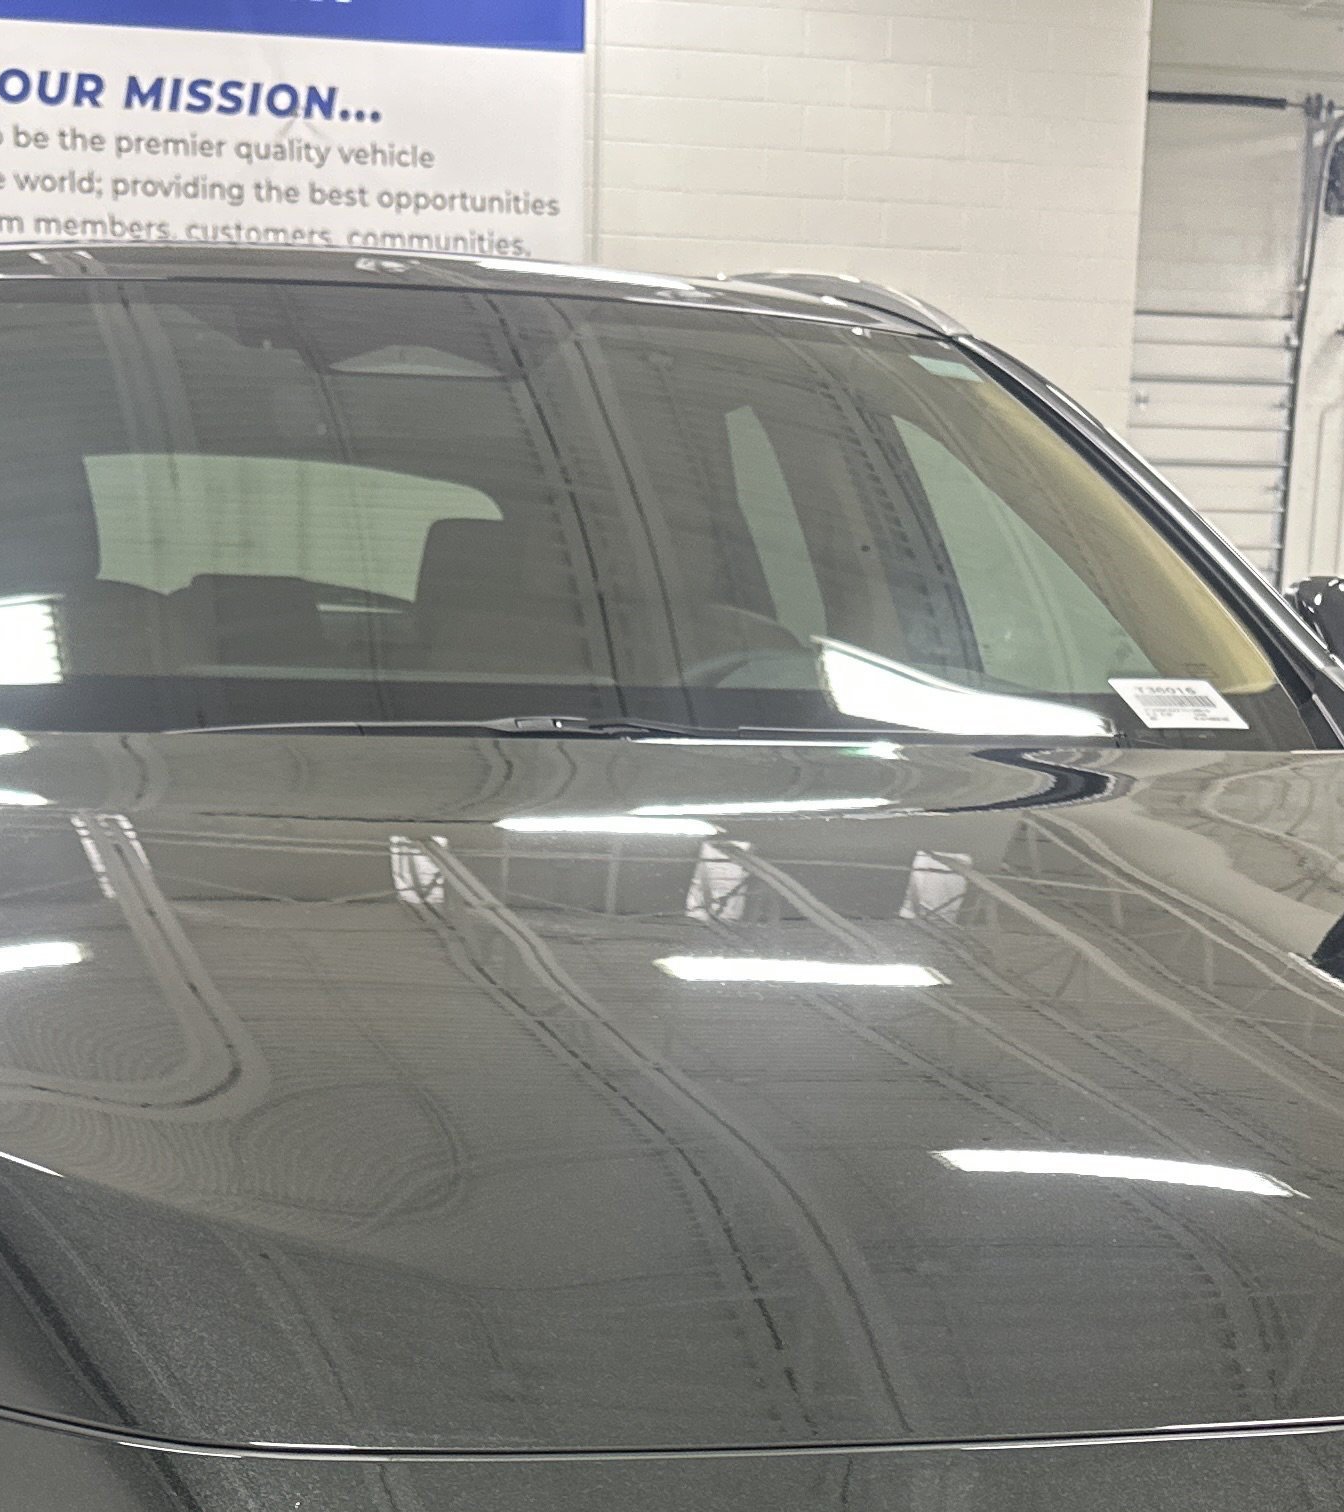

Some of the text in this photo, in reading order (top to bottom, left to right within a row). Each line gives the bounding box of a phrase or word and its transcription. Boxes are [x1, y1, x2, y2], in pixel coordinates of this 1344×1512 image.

[123, 76, 382, 122] MISSION...
[14, 124, 49, 149] be
[58, 125, 106, 152] the
[115, 131, 226, 159] premier
[234, 137, 332, 168] quality
[338, 140, 435, 169] vehicle
[13, 169, 103, 198] world;
[111, 172, 245, 206] providing
[254, 178, 300, 204] the
[309, 181, 369, 207] best
[376, 189, 561, 216] opportunities
